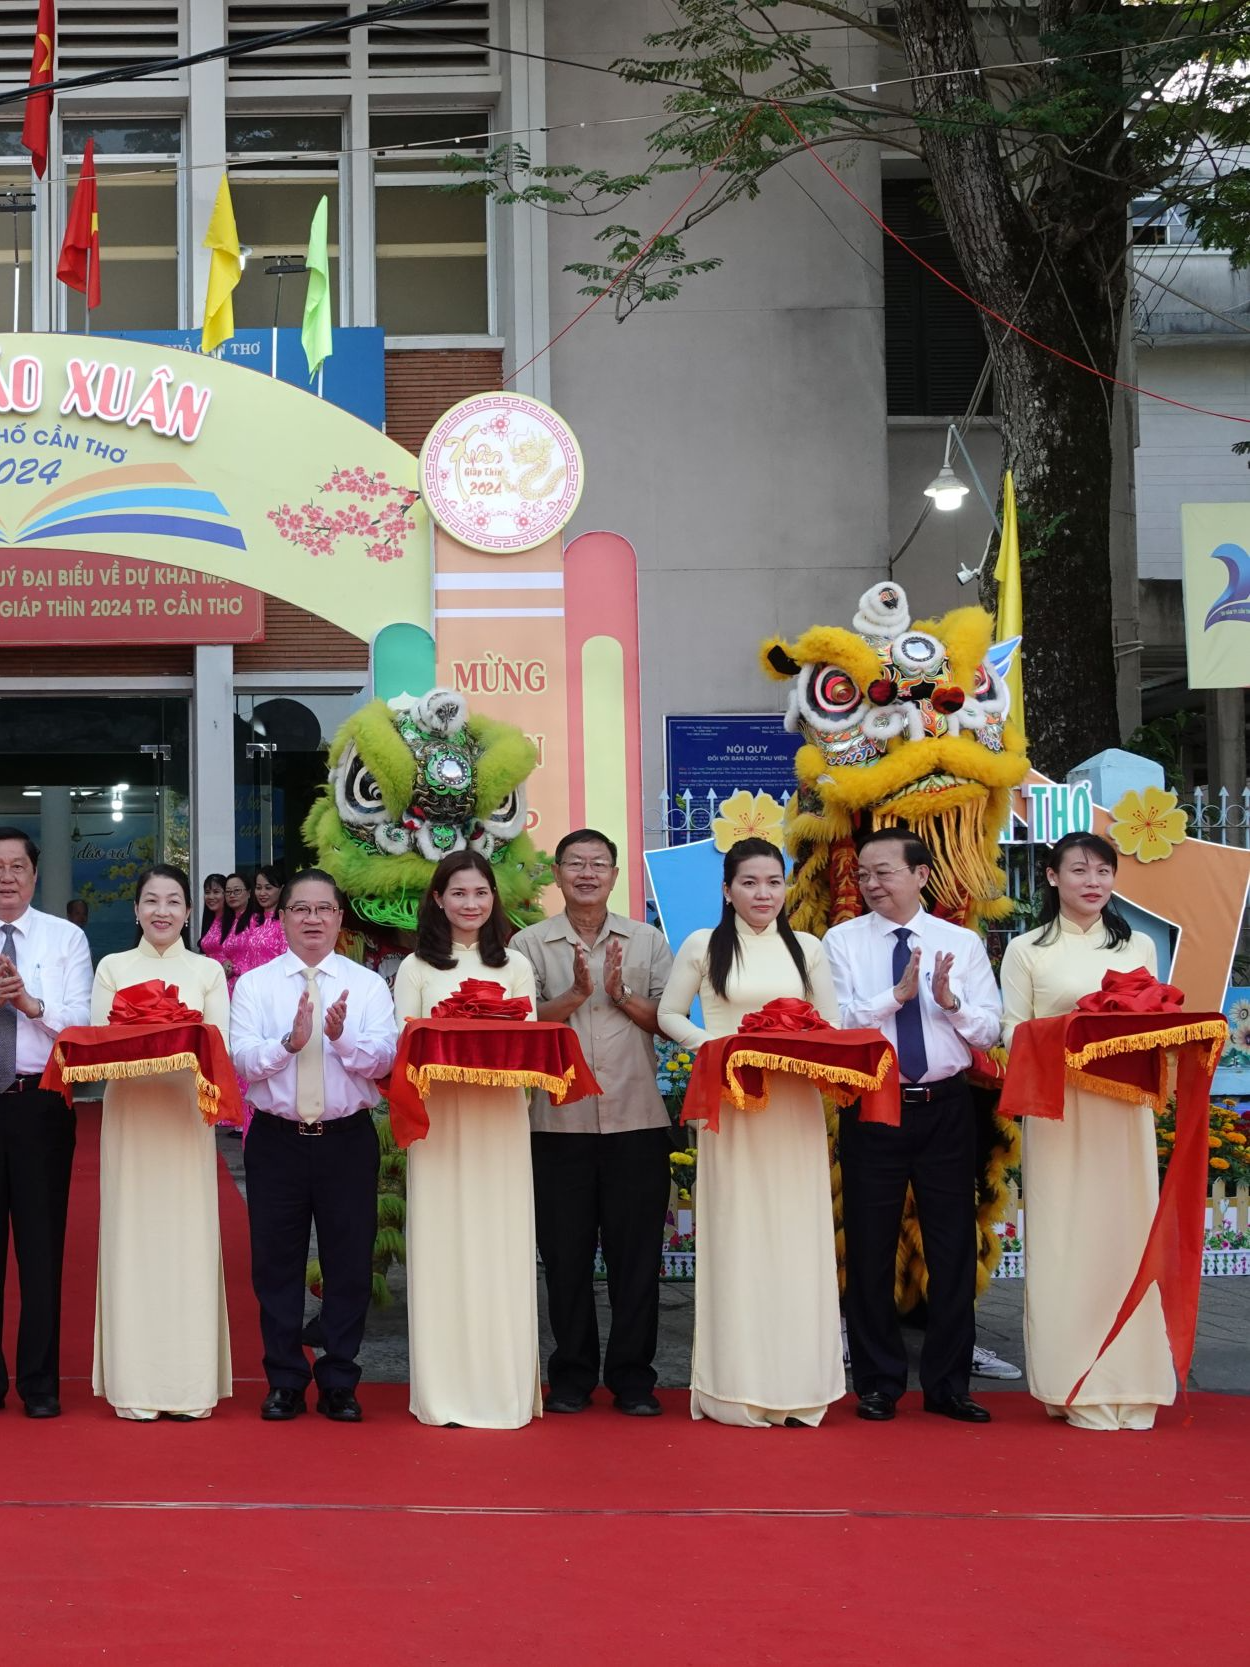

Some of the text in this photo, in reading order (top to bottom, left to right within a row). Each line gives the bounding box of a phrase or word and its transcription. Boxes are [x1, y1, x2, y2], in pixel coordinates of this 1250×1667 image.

[232, 341, 261, 354] THƠ
[61, 366, 210, 440] XUÂN
[33, 424, 79, 450] CẦN
[86, 437, 128, 464] THƠ
[470, 481, 502, 496] 2024
[22, 570, 52, 591] ĐẠI
[58, 560, 94, 586] BIỂU
[100, 560, 120, 586] VỀ
[125, 566, 150, 589] DỰ
[155, 568, 196, 585] KHAI
[0, 596, 42, 617] GIÁP
[47, 595, 85, 617] THÌN
[91, 600, 132, 616] 2024
[136, 599, 158, 616] TP.
[164, 591, 202, 615] CẦN
[207, 595, 243, 615] THƠ
[453, 653, 546, 693] MỪNG
[726, 744, 768, 755] NỘI QUY
[1030, 782, 1091, 841] THƠ
